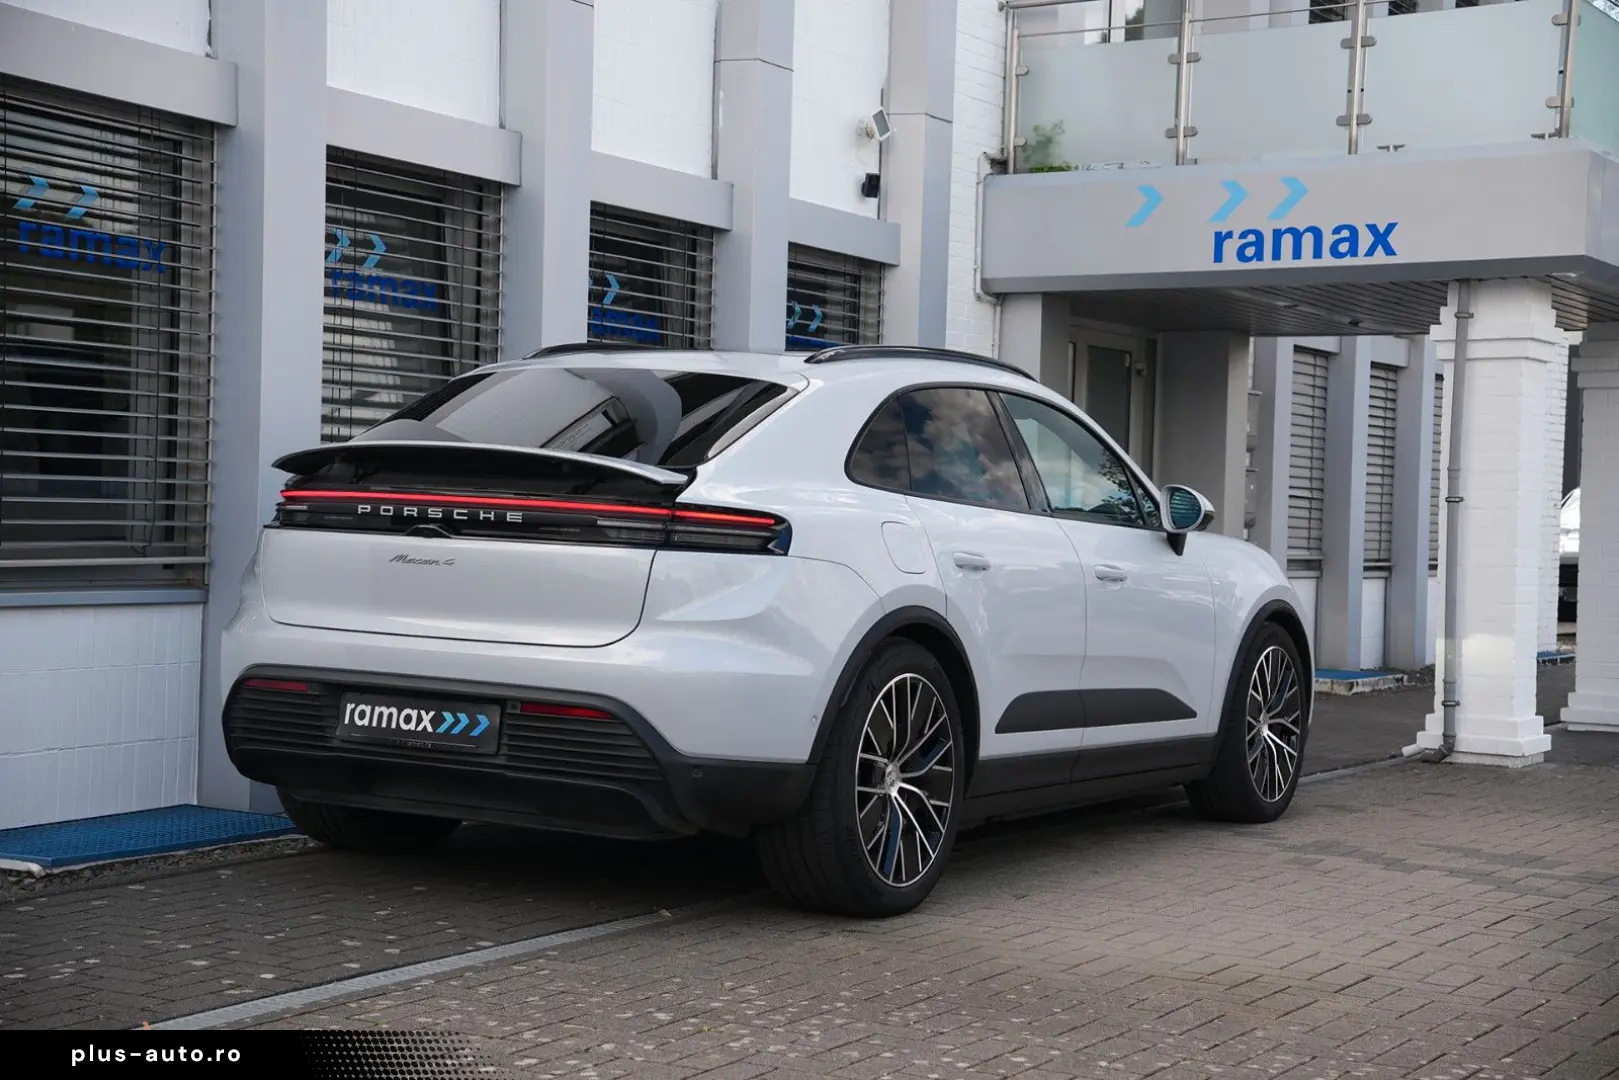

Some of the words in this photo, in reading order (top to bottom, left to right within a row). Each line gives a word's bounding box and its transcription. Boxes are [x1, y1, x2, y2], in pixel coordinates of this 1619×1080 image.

[19, 220, 168, 274] ramax
[1212, 221, 1399, 264] ramax
[357, 504, 523, 523] PORSCHE
[389, 553, 441, 566] Macan
[344, 703, 436, 733] ramax
